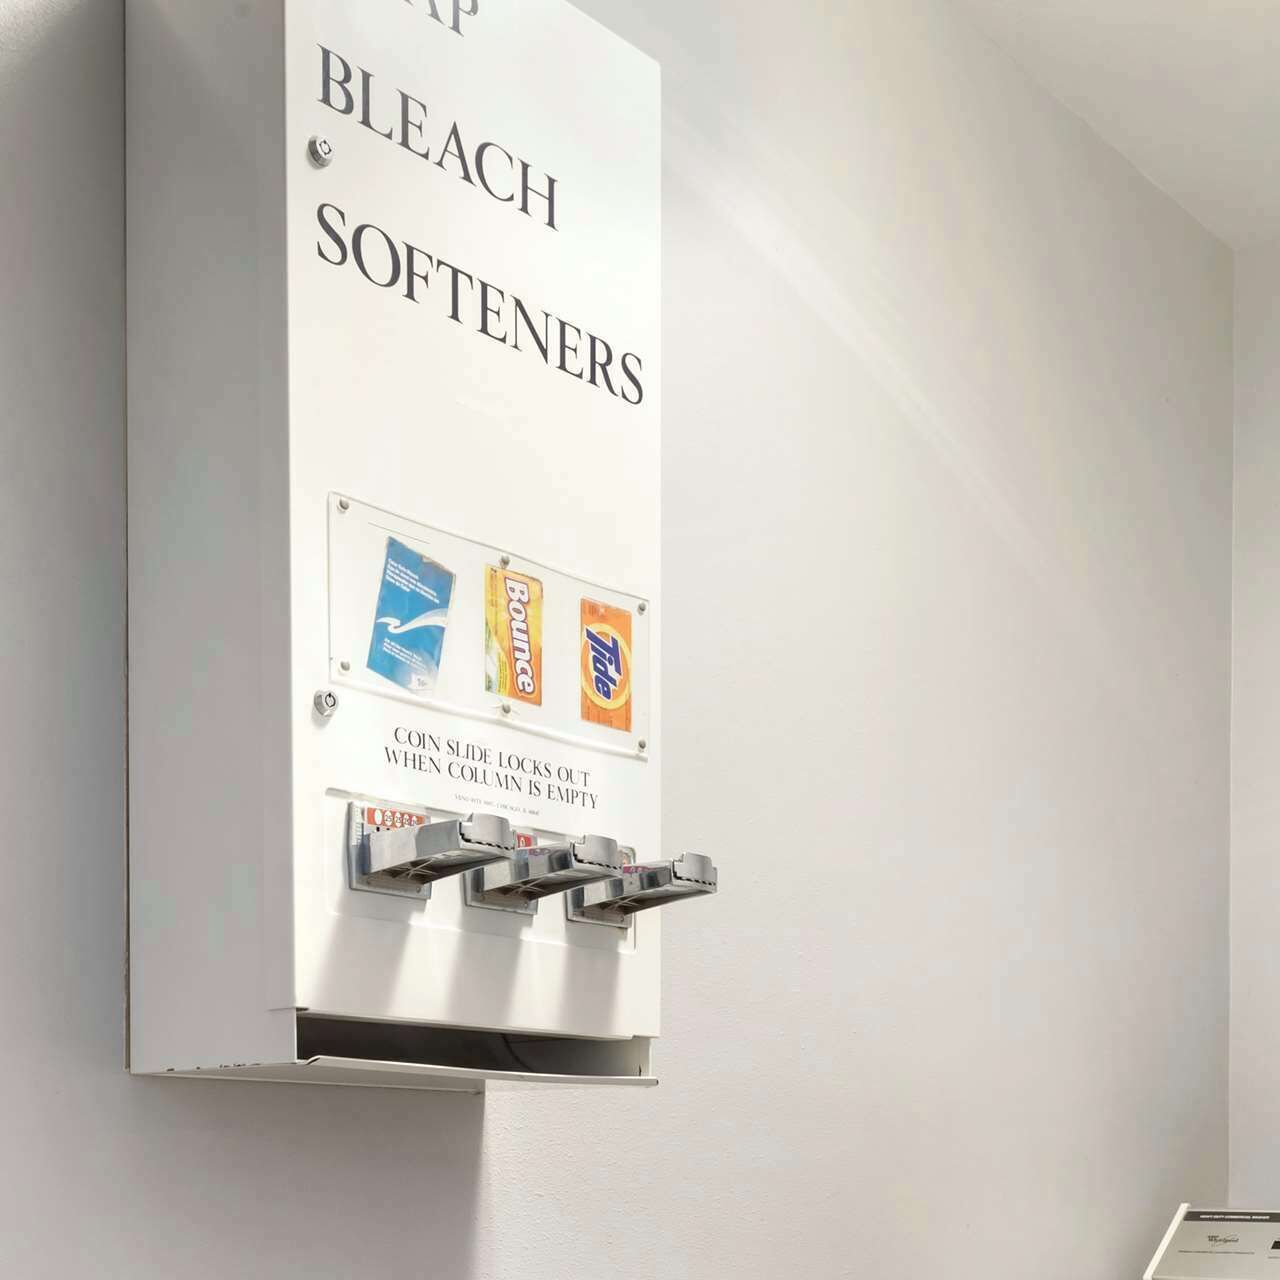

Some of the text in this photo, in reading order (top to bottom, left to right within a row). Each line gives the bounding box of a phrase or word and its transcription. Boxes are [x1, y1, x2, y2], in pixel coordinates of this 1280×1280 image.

[317, 43, 559, 231] BLEACH
[317, 203, 643, 404] SOFTENERS
[504, 577, 535, 694] Bounce
[584, 626, 622, 701] Tide
[385, 746, 441, 774] WHEN
[448, 761, 522, 792] COLUMN
[529, 780, 541, 797] IS
[547, 784, 598, 809] EMPTY
[394, 727, 590, 787] COIN SLIDE LOCKS OUT
